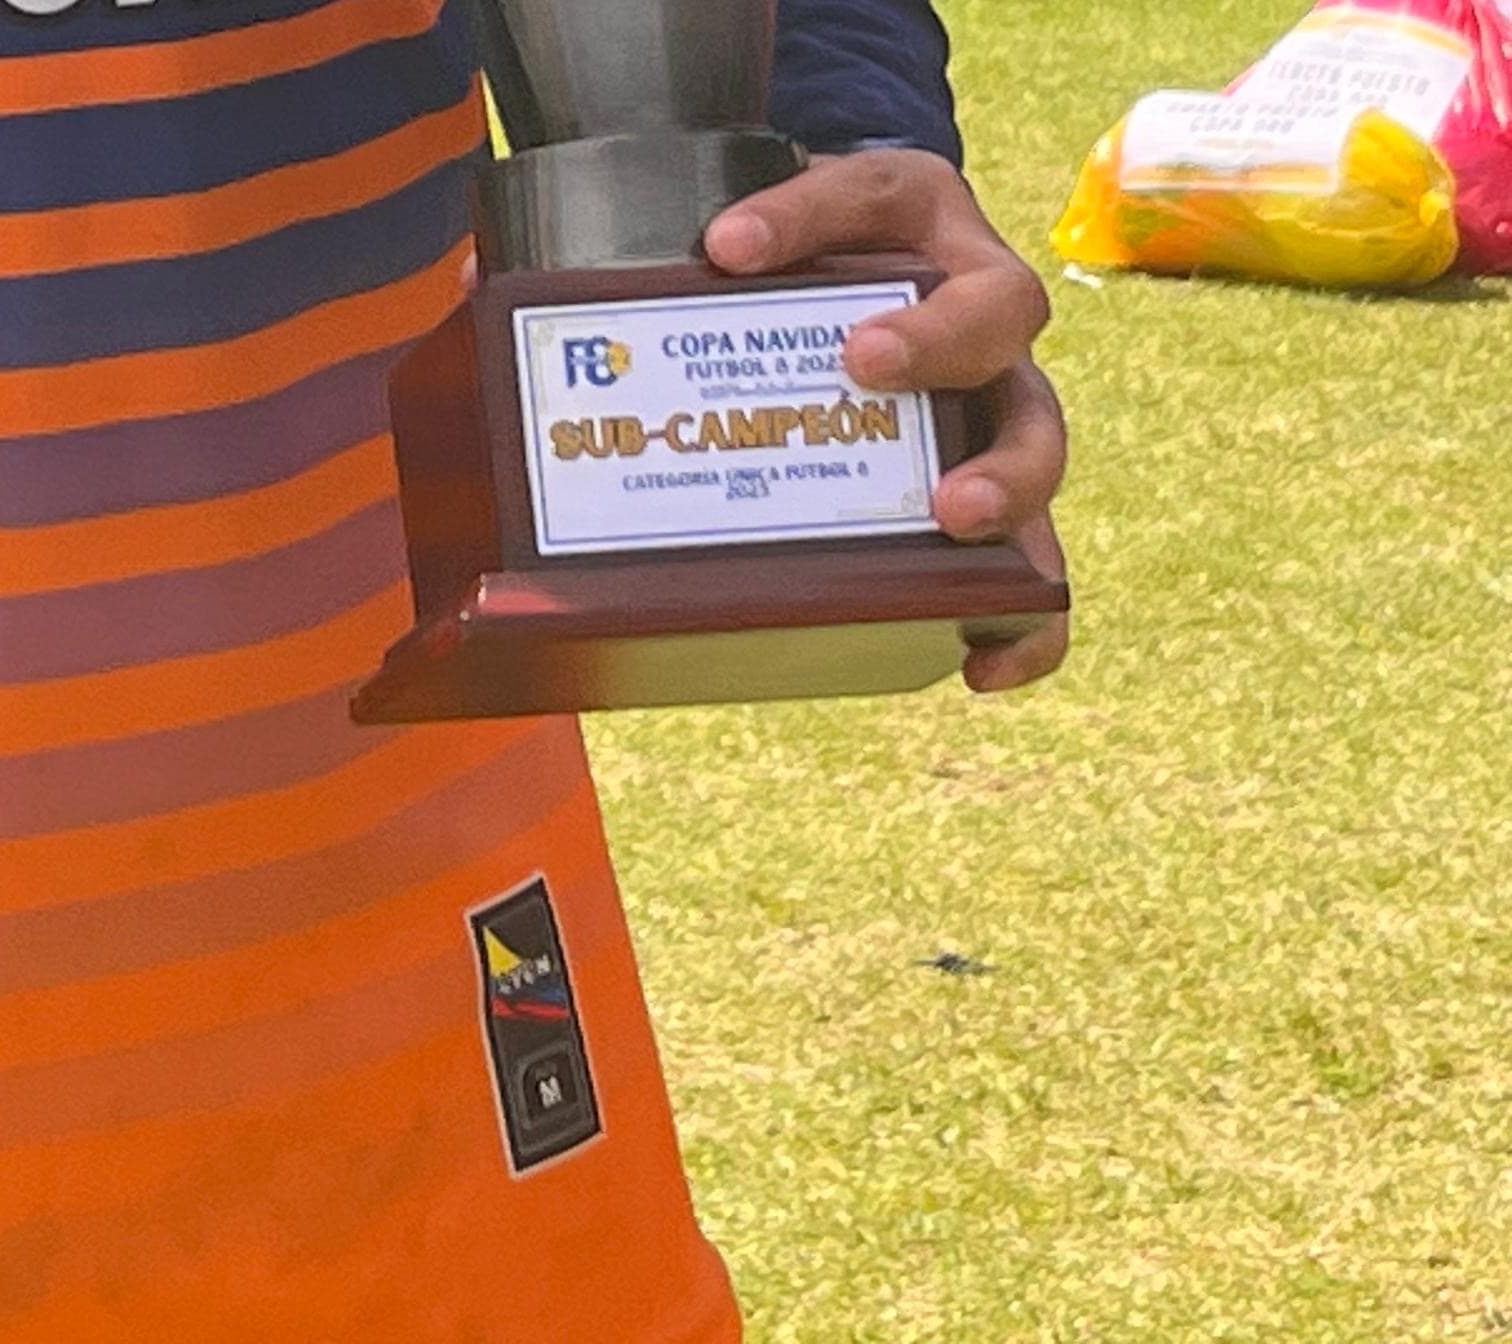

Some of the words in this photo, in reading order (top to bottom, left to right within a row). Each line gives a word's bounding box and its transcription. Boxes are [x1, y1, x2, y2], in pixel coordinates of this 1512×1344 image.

[662, 332, 735, 358] COPA
[745, 324, 854, 352] NAVIDA
[797, 353, 844, 375] 202
